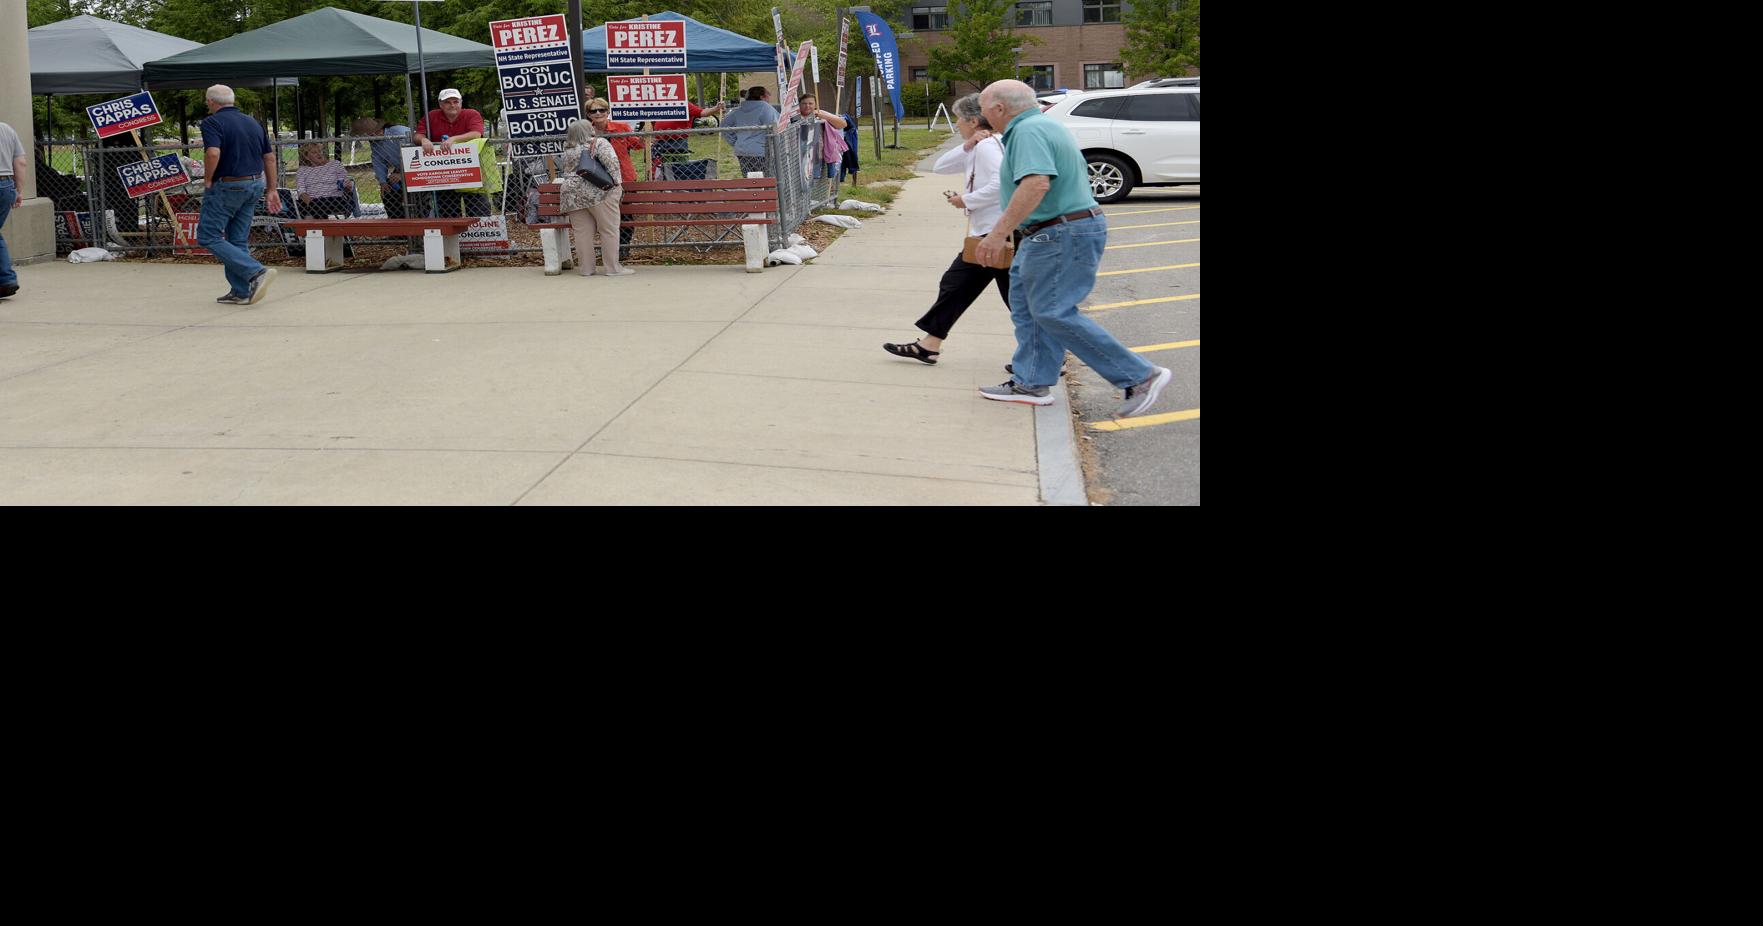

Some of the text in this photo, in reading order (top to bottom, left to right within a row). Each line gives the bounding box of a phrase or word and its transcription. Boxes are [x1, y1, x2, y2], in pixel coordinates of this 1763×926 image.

[511, 19, 543, 28] KRISTINE
[499, 24, 560, 46] PEREZ
[614, 30, 677, 47] PEREZ
[524, 50, 568, 60] Representative
[637, 56, 683, 64] Representative
[520, 66, 550, 75] DON
[883, 52, 895, 90] PARKING
[502, 71, 571, 89] BOLDUC
[616, 84, 678, 101] PEREZ
[92, 99, 134, 117] CHRIS
[505, 94, 576, 110] U. S. SENATE
[95, 104, 152, 127] PAPPAS
[527, 112, 557, 120] DON
[640, 109, 686, 117] Representative
[118, 115, 157, 129] CONGRESS
[513, 145, 524, 155] U.
[526, 143, 538, 154] S.
[122, 159, 162, 177] CHRIS
[424, 157, 473, 167] CONGRESS
[126, 164, 180, 187] PAPPAS
[147, 175, 185, 189] CONGRESS
